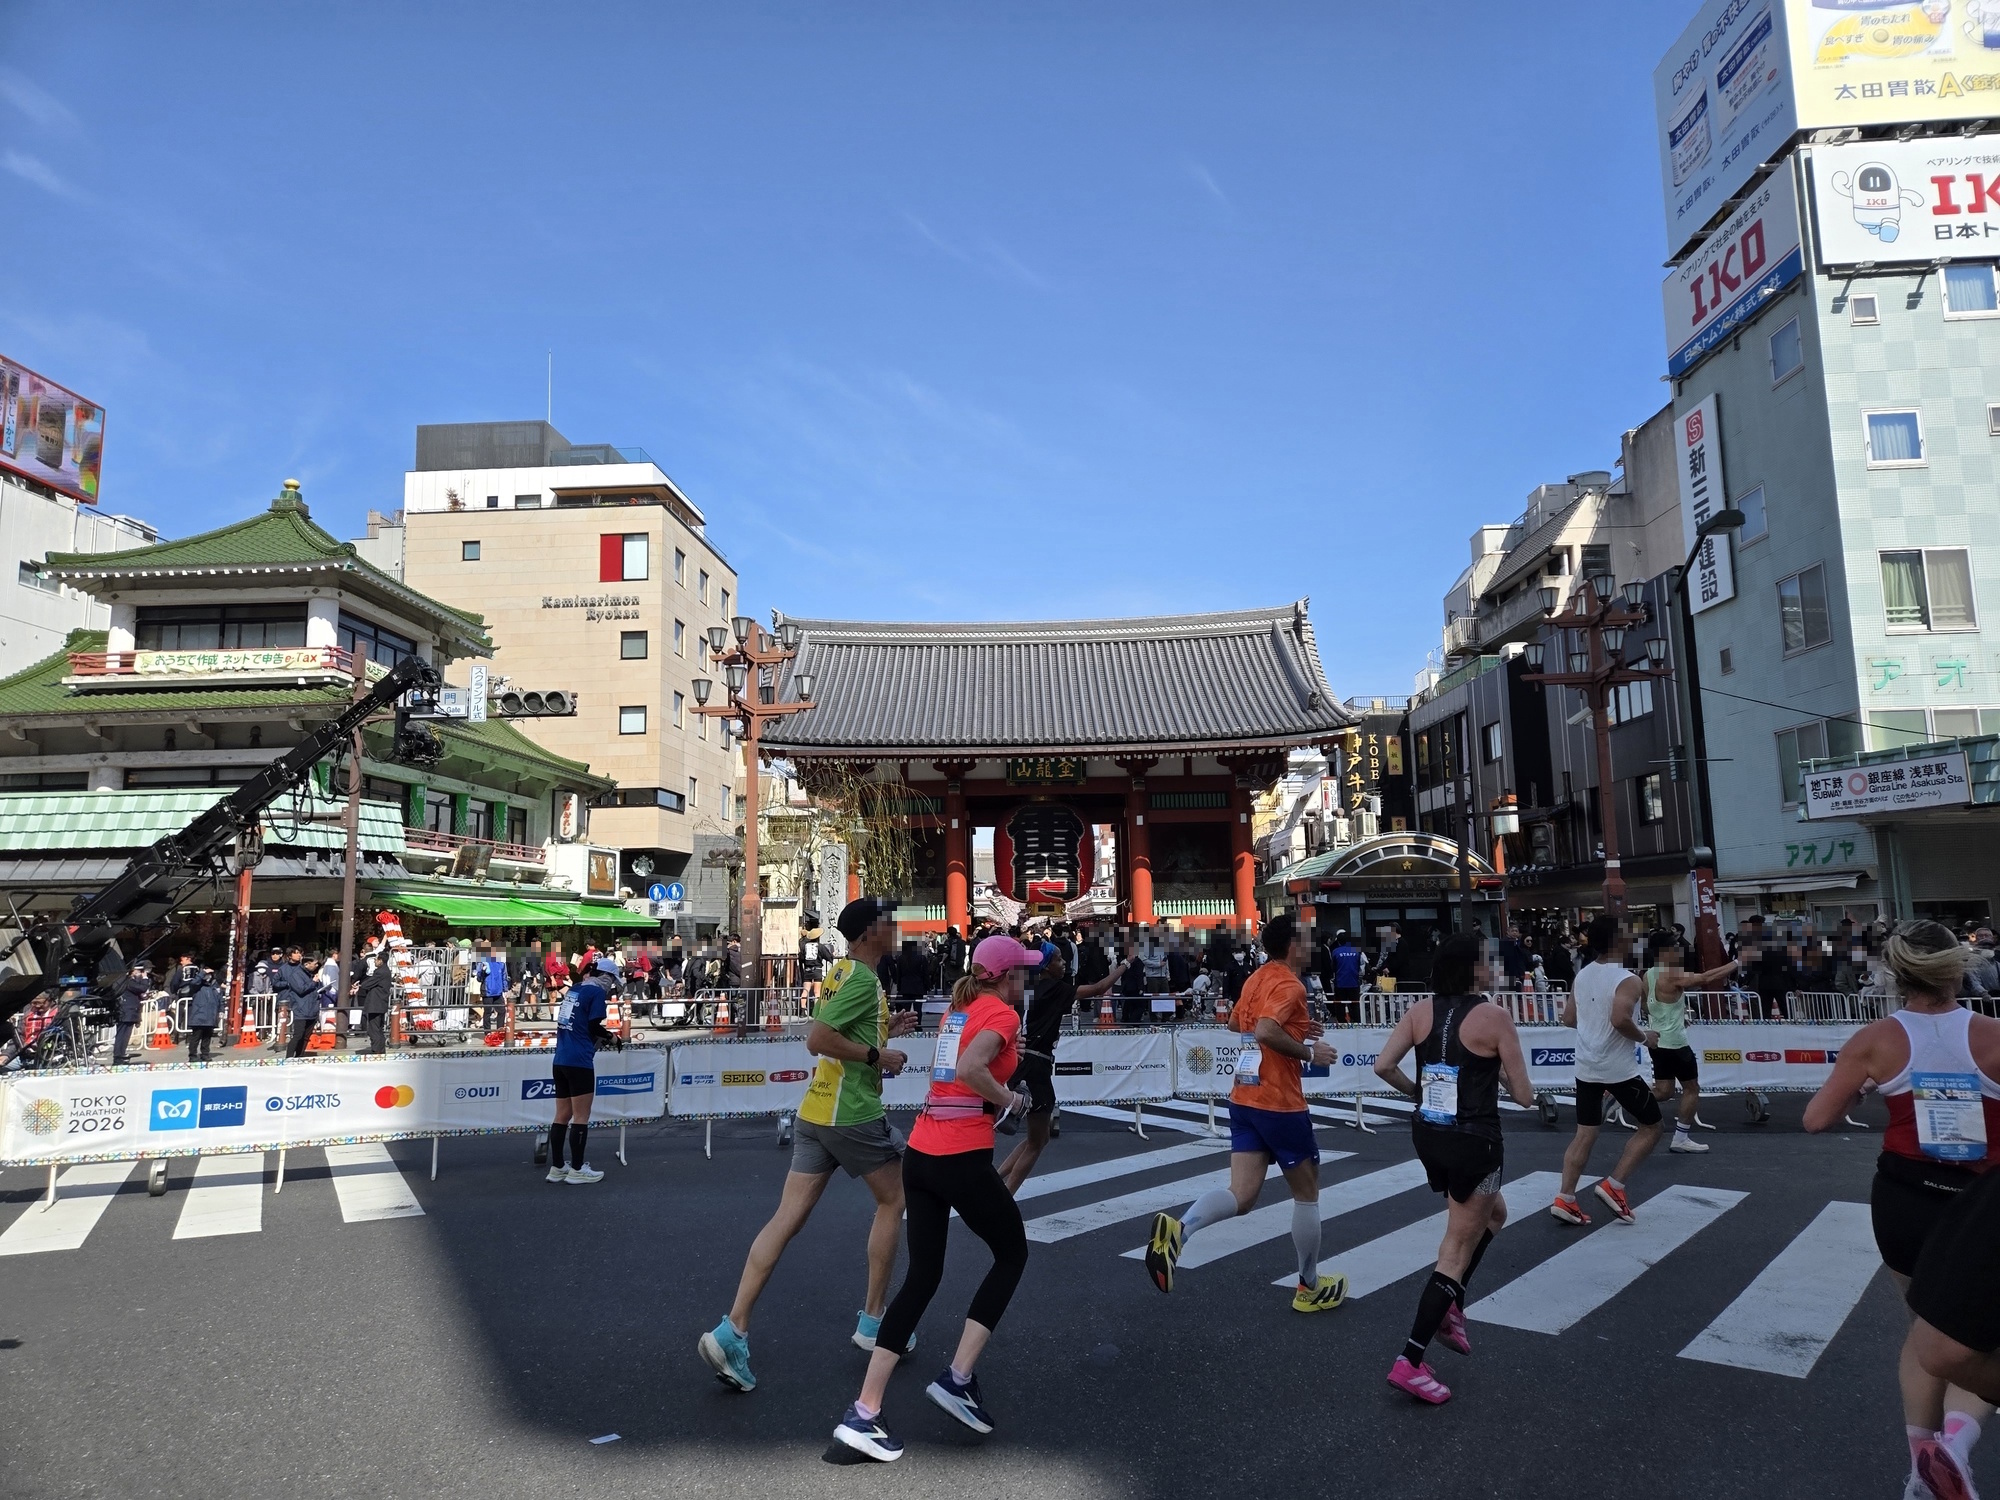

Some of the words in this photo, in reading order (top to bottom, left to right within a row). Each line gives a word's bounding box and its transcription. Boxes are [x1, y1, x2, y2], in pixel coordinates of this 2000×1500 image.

[1861, 13, 1911, 26] 胃のもたれ
[1825, 33, 1865, 46] 食べすぎ
[1893, 34, 1936, 46] 胃の痛み
[542, 594, 640, 609] Kaminarimon
[586, 607, 640, 624] Ryokan
[155, 653, 218, 667] おうちで作成
[222, 653, 284, 666] ネットで申告
[472, 667, 483, 720] スクランブル式
[1368, 733, 1380, 780] KOBE
[1810, 776, 1844, 792] 地下鉄
[1867, 769, 1906, 785] 銀座線
[1909, 762, 1949, 779] 浅草駅
[1812, 788, 1844, 800] SUBWAY
[1910, 775, 1946, 789] Asakusa
[1947, 773, 1965, 785] Sta.
[1785, 841, 1855, 867] アオノヤ
[1216, 1047, 1243, 1056] TOKY
[1704, 1052, 1740, 1061] SEIKO
[1216, 1064, 1235, 1075] 20
[598, 1077, 626, 1085] POCARI
[627, 1075, 652, 1084] SWEAT
[722, 1073, 765, 1083] SEIKO
[774, 1072, 805, 1081] 第一生命
[468, 1086, 499, 1098] OUJI
[70, 1095, 127, 1107] TOKYO
[203, 1101, 243, 1112] 東京メトロ
[285, 1093, 341, 1110] STARTS
[69, 1107, 126, 1117] MARATHON
[68, 1116, 125, 1134] 2026
[1923, 1180, 1965, 1193] SALOMO
